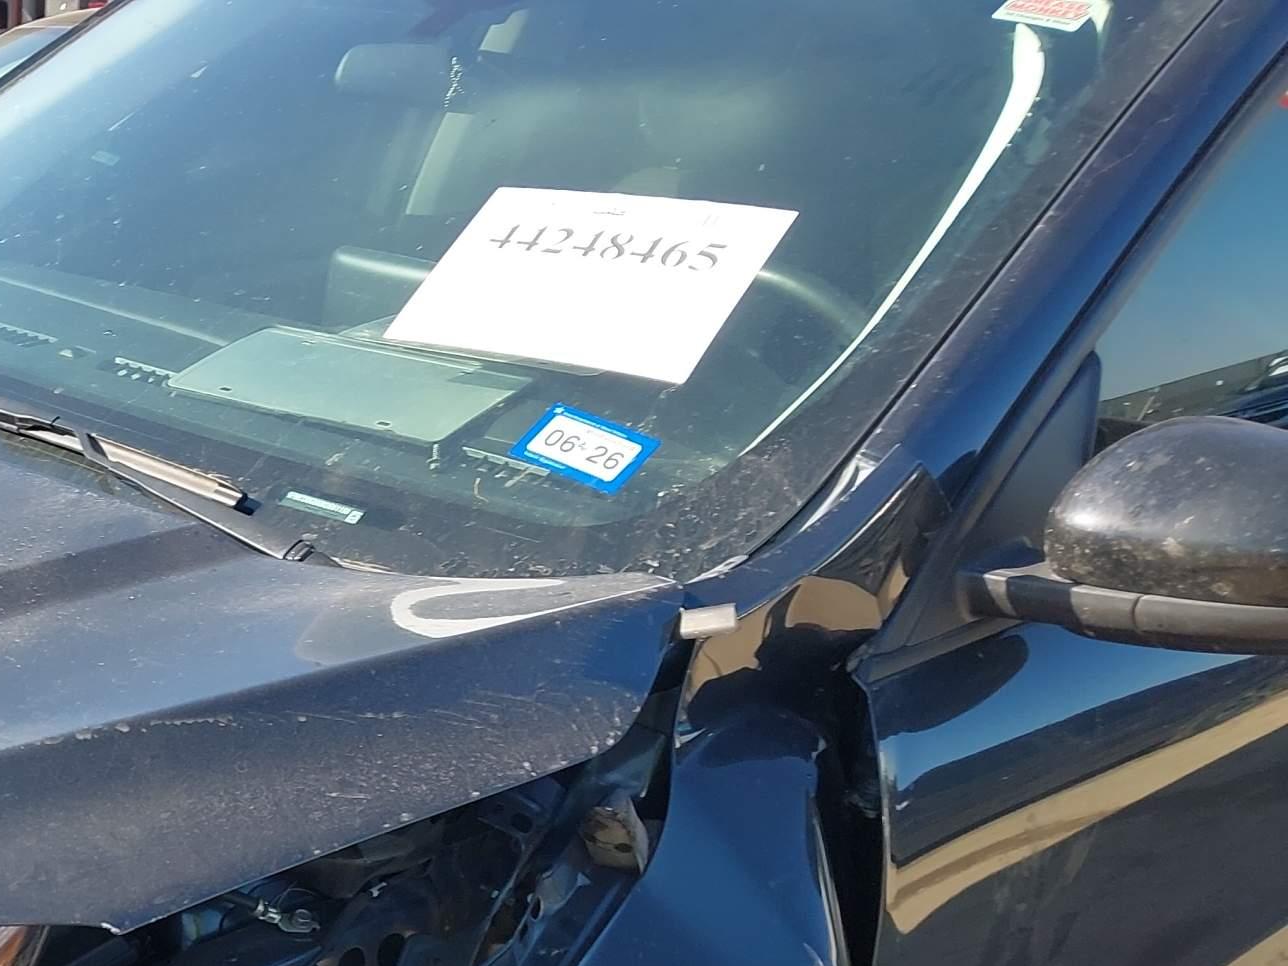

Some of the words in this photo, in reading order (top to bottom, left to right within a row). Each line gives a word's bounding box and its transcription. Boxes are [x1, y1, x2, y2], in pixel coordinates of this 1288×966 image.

[488, 223, 728, 271] 44248465
[543, 429, 581, 453] 06
[584, 445, 625, 470] 26
